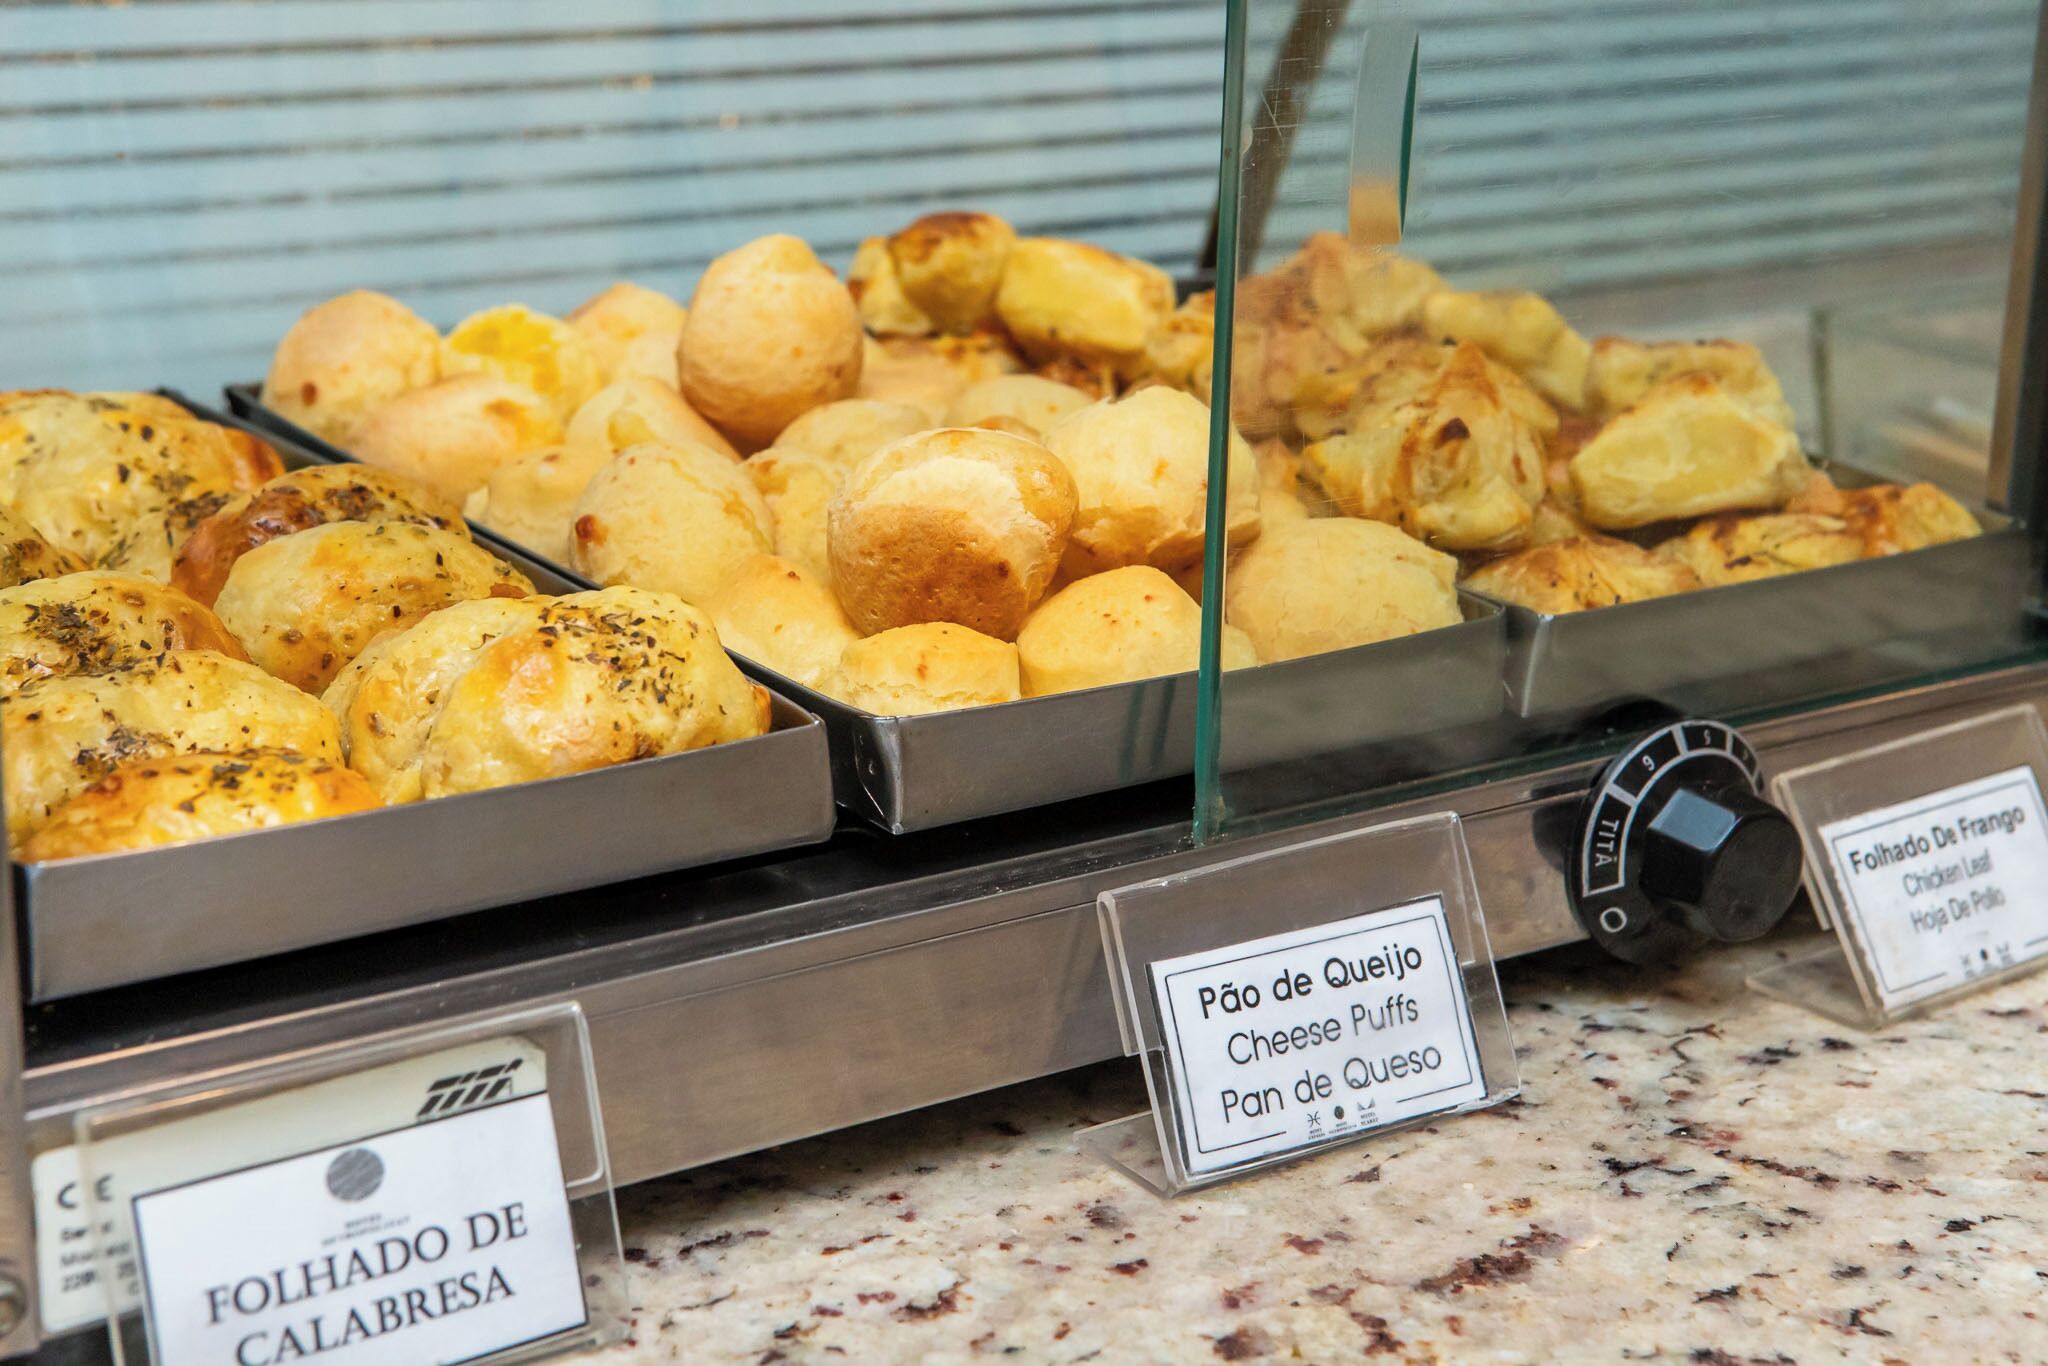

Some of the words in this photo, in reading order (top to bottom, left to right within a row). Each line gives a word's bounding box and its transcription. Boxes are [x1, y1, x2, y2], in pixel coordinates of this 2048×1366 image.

[1848, 834, 1930, 875] Folhado
[1931, 826, 1957, 849] De
[1957, 806, 2026, 841] Frango
[1198, 981, 1261, 1020] Pão
[1272, 968, 1313, 1002] de
[1323, 942, 1422, 989] Queijo
[1227, 1017, 1341, 1065] Cheese
[1351, 992, 1419, 1037] Puffs
[1221, 1084, 1285, 1124] Pan
[1294, 1069, 1333, 1104] de
[1343, 1045, 1442, 1090] Queso
[204, 1225, 450, 1327] FOLHADO
[464, 1201, 528, 1252] DE
[235, 1264, 517, 1366] CALABRESA
